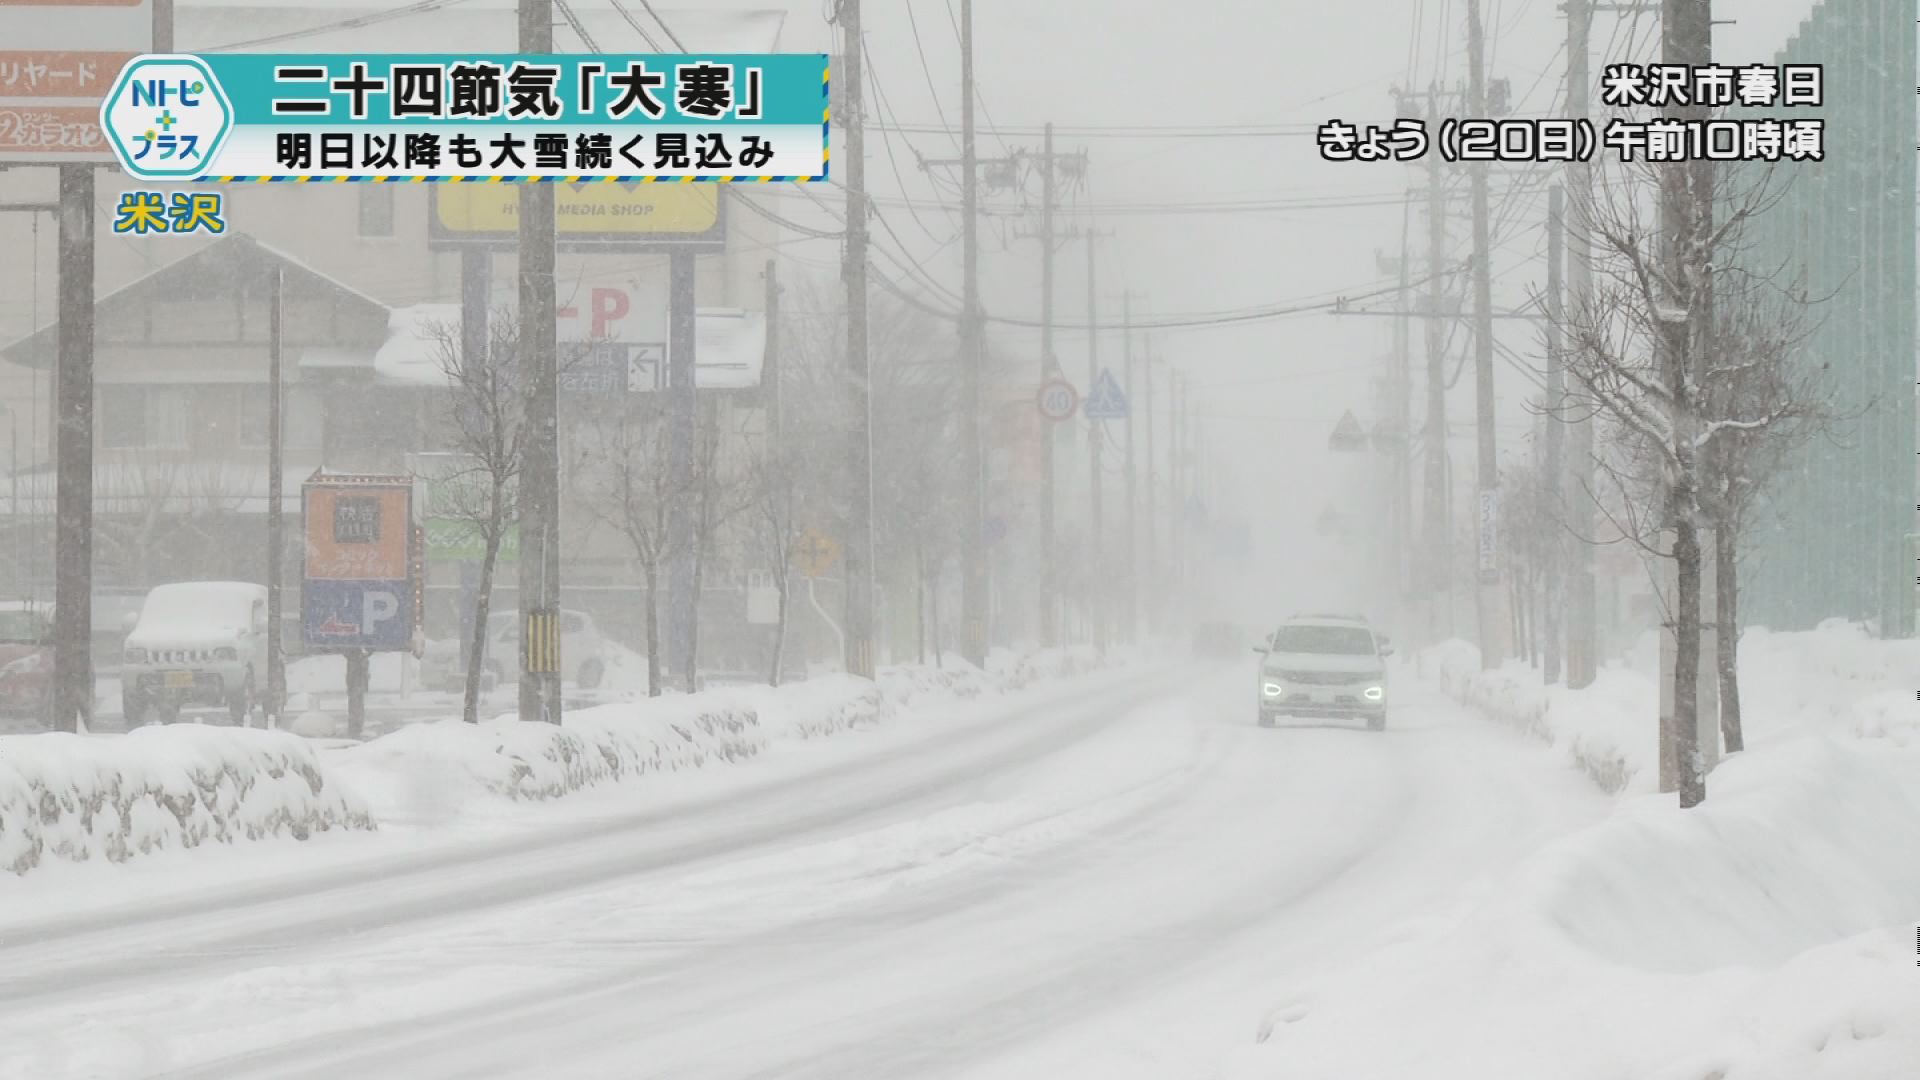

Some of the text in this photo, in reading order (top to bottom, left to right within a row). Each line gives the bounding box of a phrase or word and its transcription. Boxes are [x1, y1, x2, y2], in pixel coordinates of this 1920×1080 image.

[557, 203, 655, 216] MEDIA SHOP
[591, 287, 631, 337] P
[1046, 390, 1070, 410] 40
[362, 591, 399, 635] P
